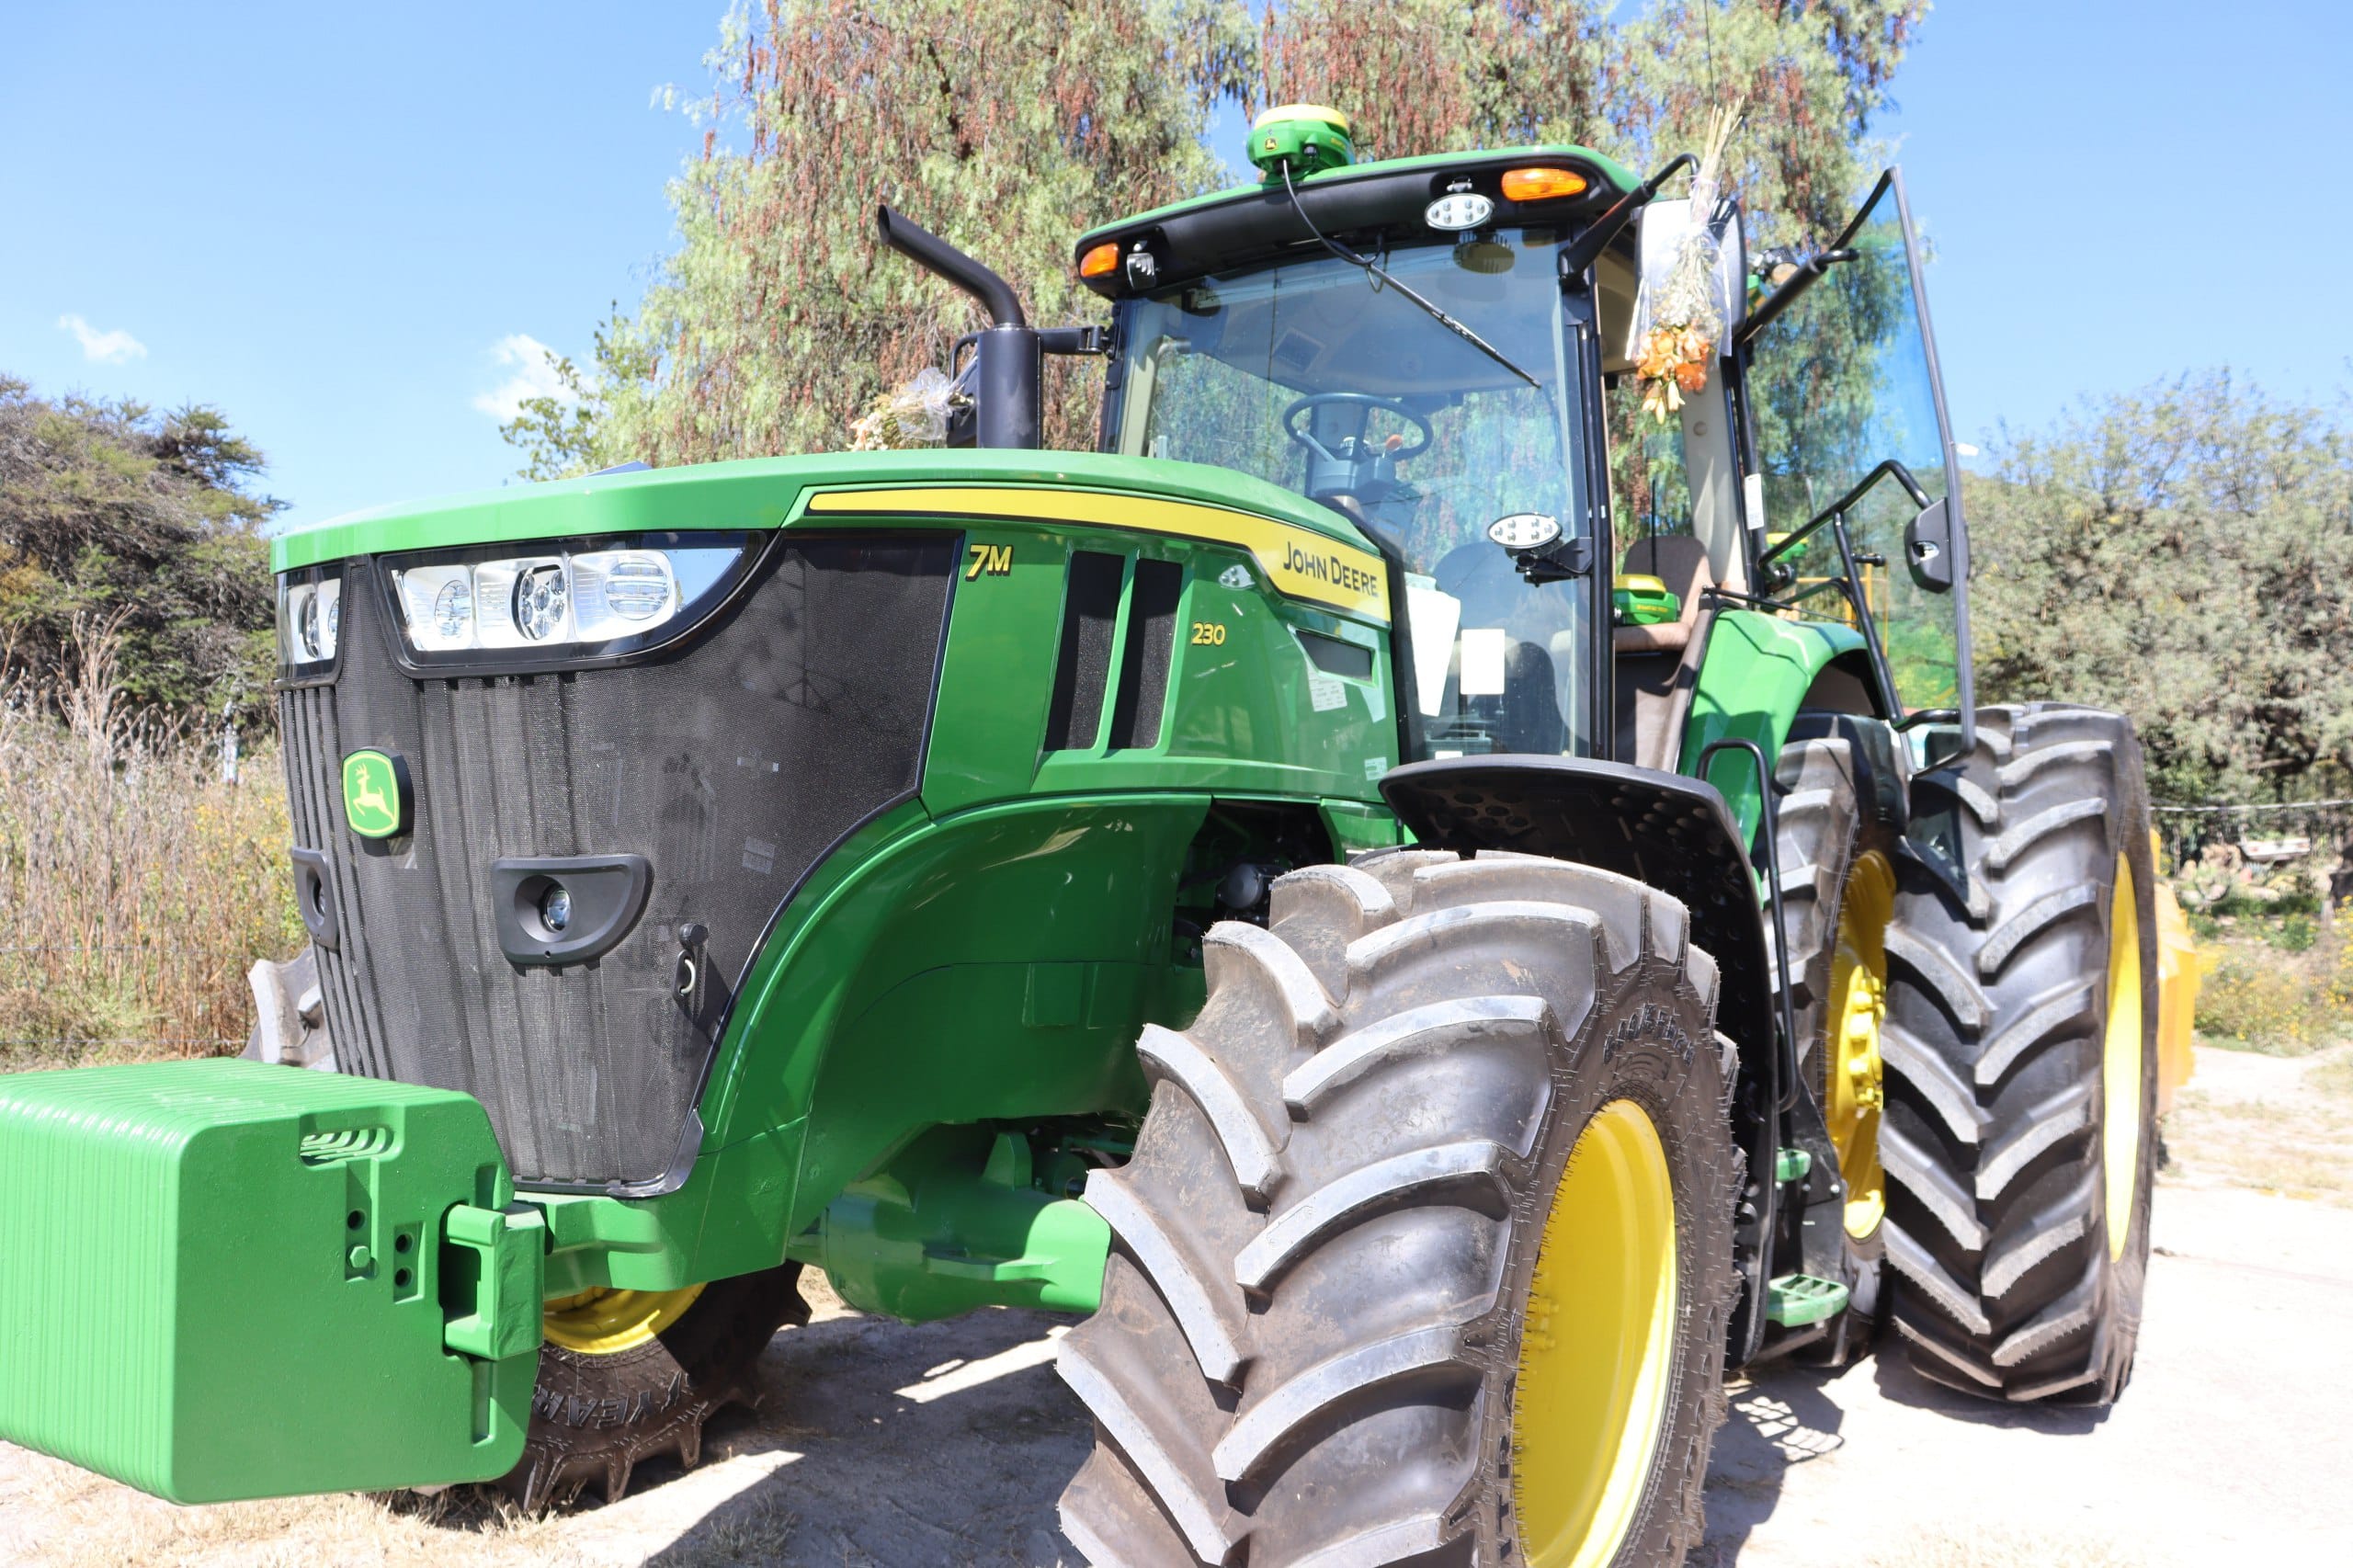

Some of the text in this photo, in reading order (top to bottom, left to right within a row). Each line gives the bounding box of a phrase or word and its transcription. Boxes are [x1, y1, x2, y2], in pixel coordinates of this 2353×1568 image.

[966, 544, 1013, 581] 7M
[1283, 541, 1379, 597] JOHN DEERE
[1191, 621, 1226, 646] 230
